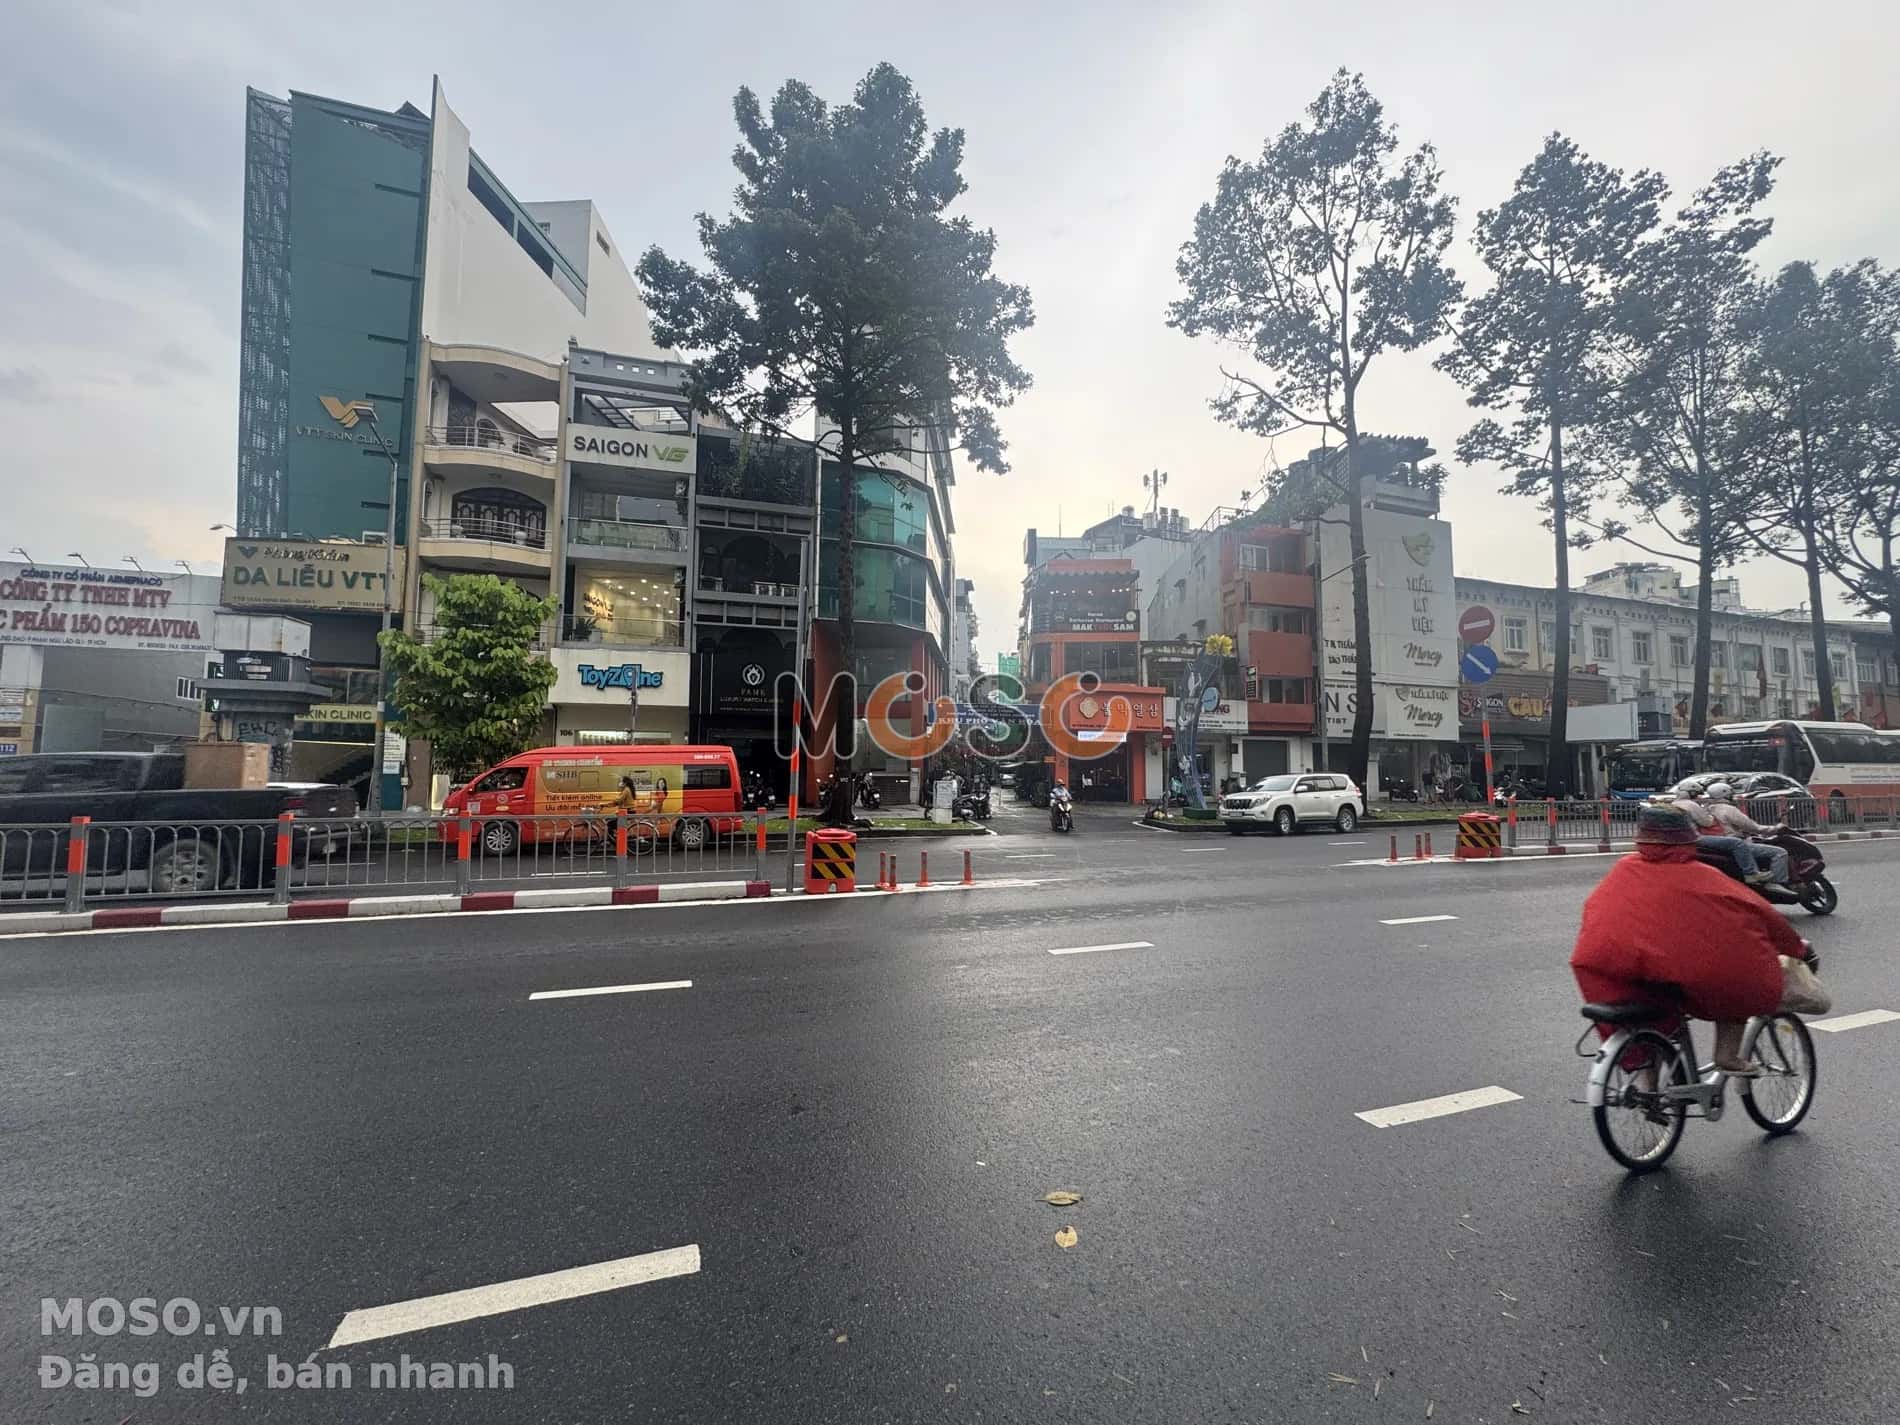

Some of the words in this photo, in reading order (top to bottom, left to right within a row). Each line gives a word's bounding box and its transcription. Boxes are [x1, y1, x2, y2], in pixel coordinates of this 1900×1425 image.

[574, 435, 648, 458] SAIGON
[232, 566, 270, 586] DA
[276, 563, 334, 588] LIỄU
[0, 576, 48, 600] CÔNG
[50, 582, 76, 602] TY
[80, 584, 130, 607] TNHH
[132, 588, 173, 608] MTV
[11, 603, 66, 633] PHẨM
[70, 613, 102, 634] 150
[104, 616, 201, 640] COPHAVINA
[330, 709, 372, 721] CLINIC
